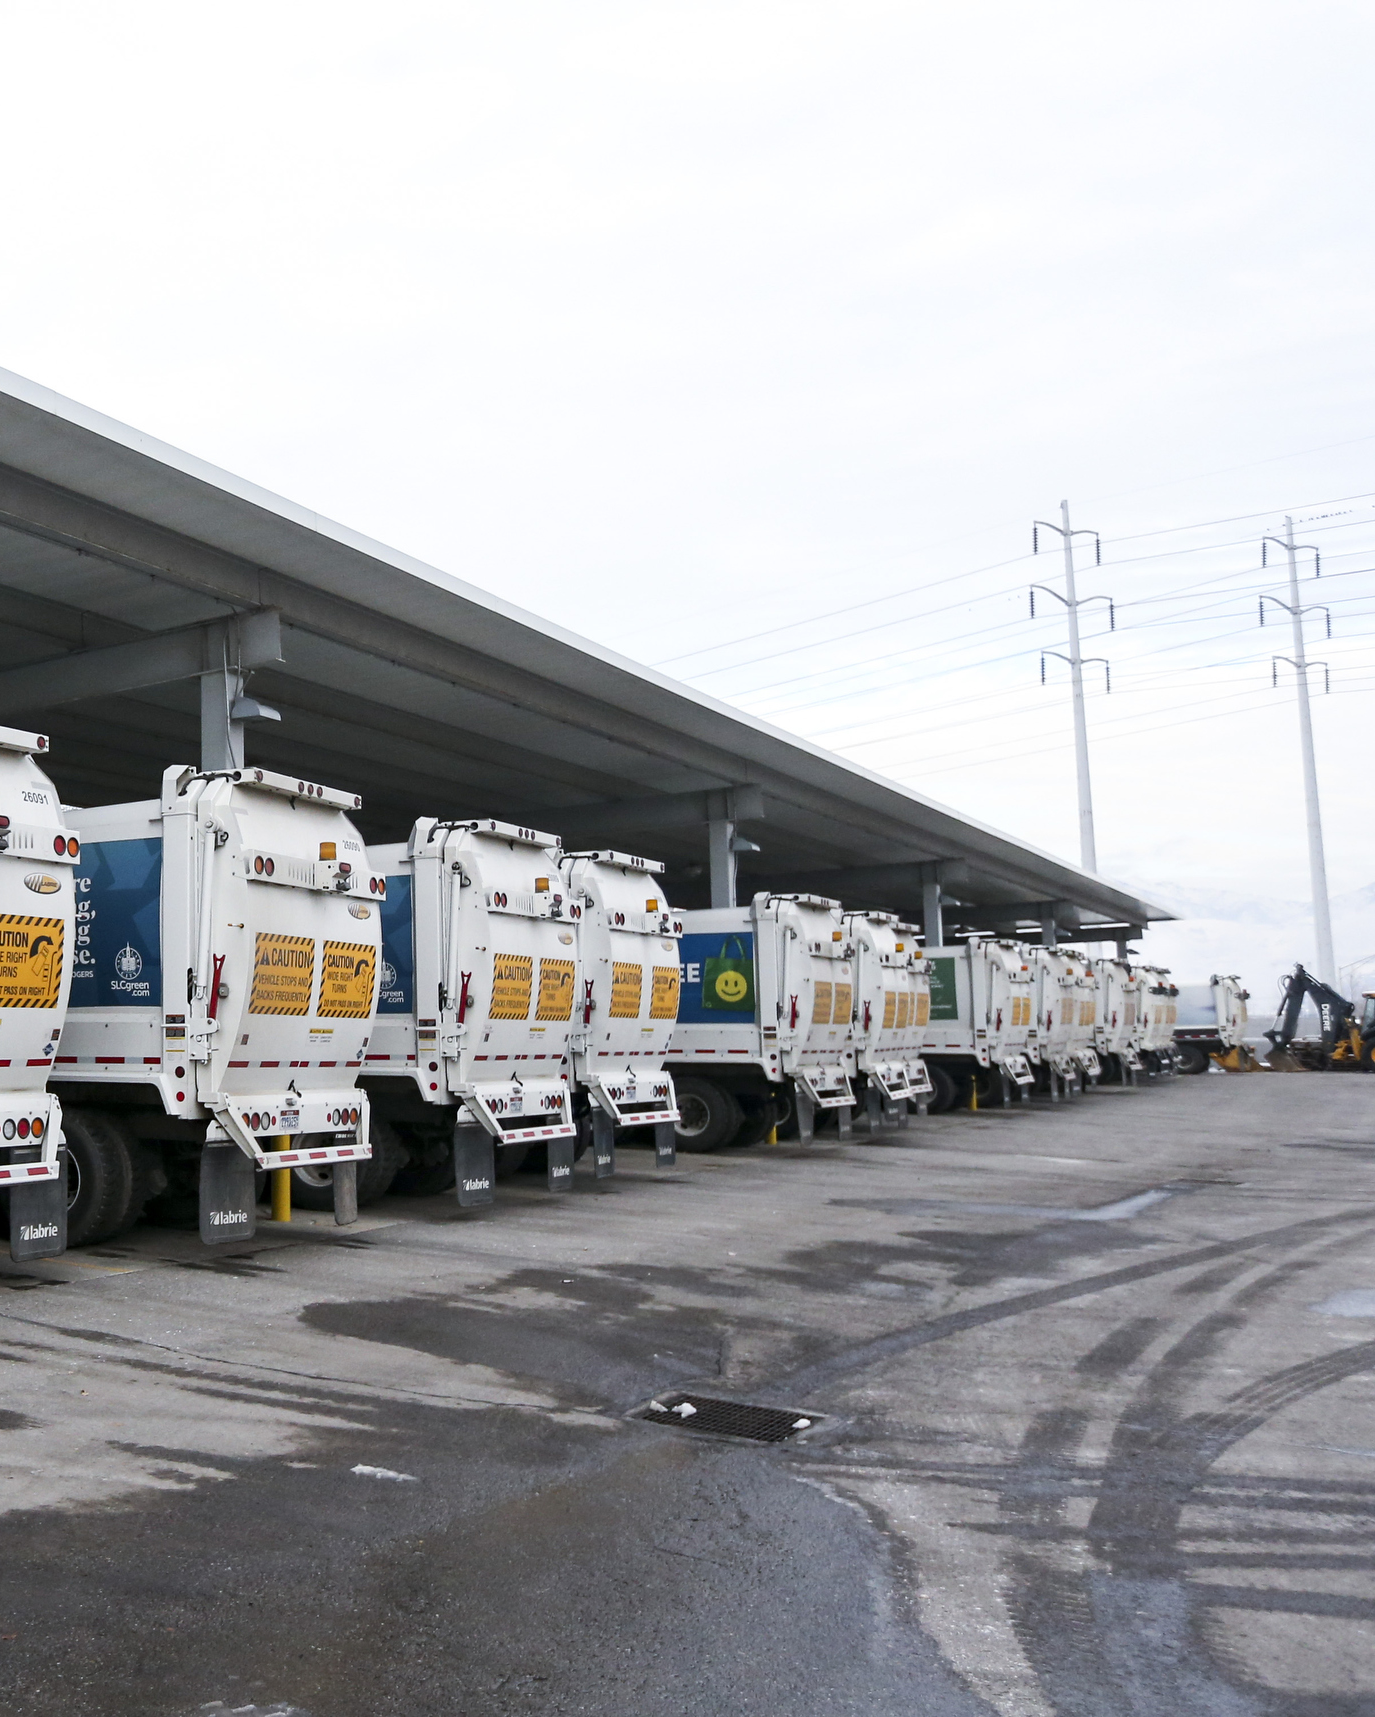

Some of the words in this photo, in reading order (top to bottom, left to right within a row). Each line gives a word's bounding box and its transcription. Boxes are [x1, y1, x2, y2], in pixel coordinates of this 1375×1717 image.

[21, 790, 49, 805] 26091
[5, 952, 28, 964] RIGHT
[271, 948, 311, 969] CAUTION
[327, 954, 355, 970] CAUTION
[257, 974, 279, 986] VEHICLE
[281, 975, 298, 986] STOPS
[505, 965, 530, 982] CAUTION
[3, 986, 18, 995] PASS
[19, 986, 27, 996] ON
[28, 986, 46, 996] RIGHT
[111, 980, 149, 992] SLCgreen
[256, 990, 274, 1000] BACKS
[1321, 1004, 1331, 1032] DEERE
[469, 1178, 490, 1191] labrie
[220, 1209, 247, 1225] labrie
[29, 1222, 58, 1240] labrie
